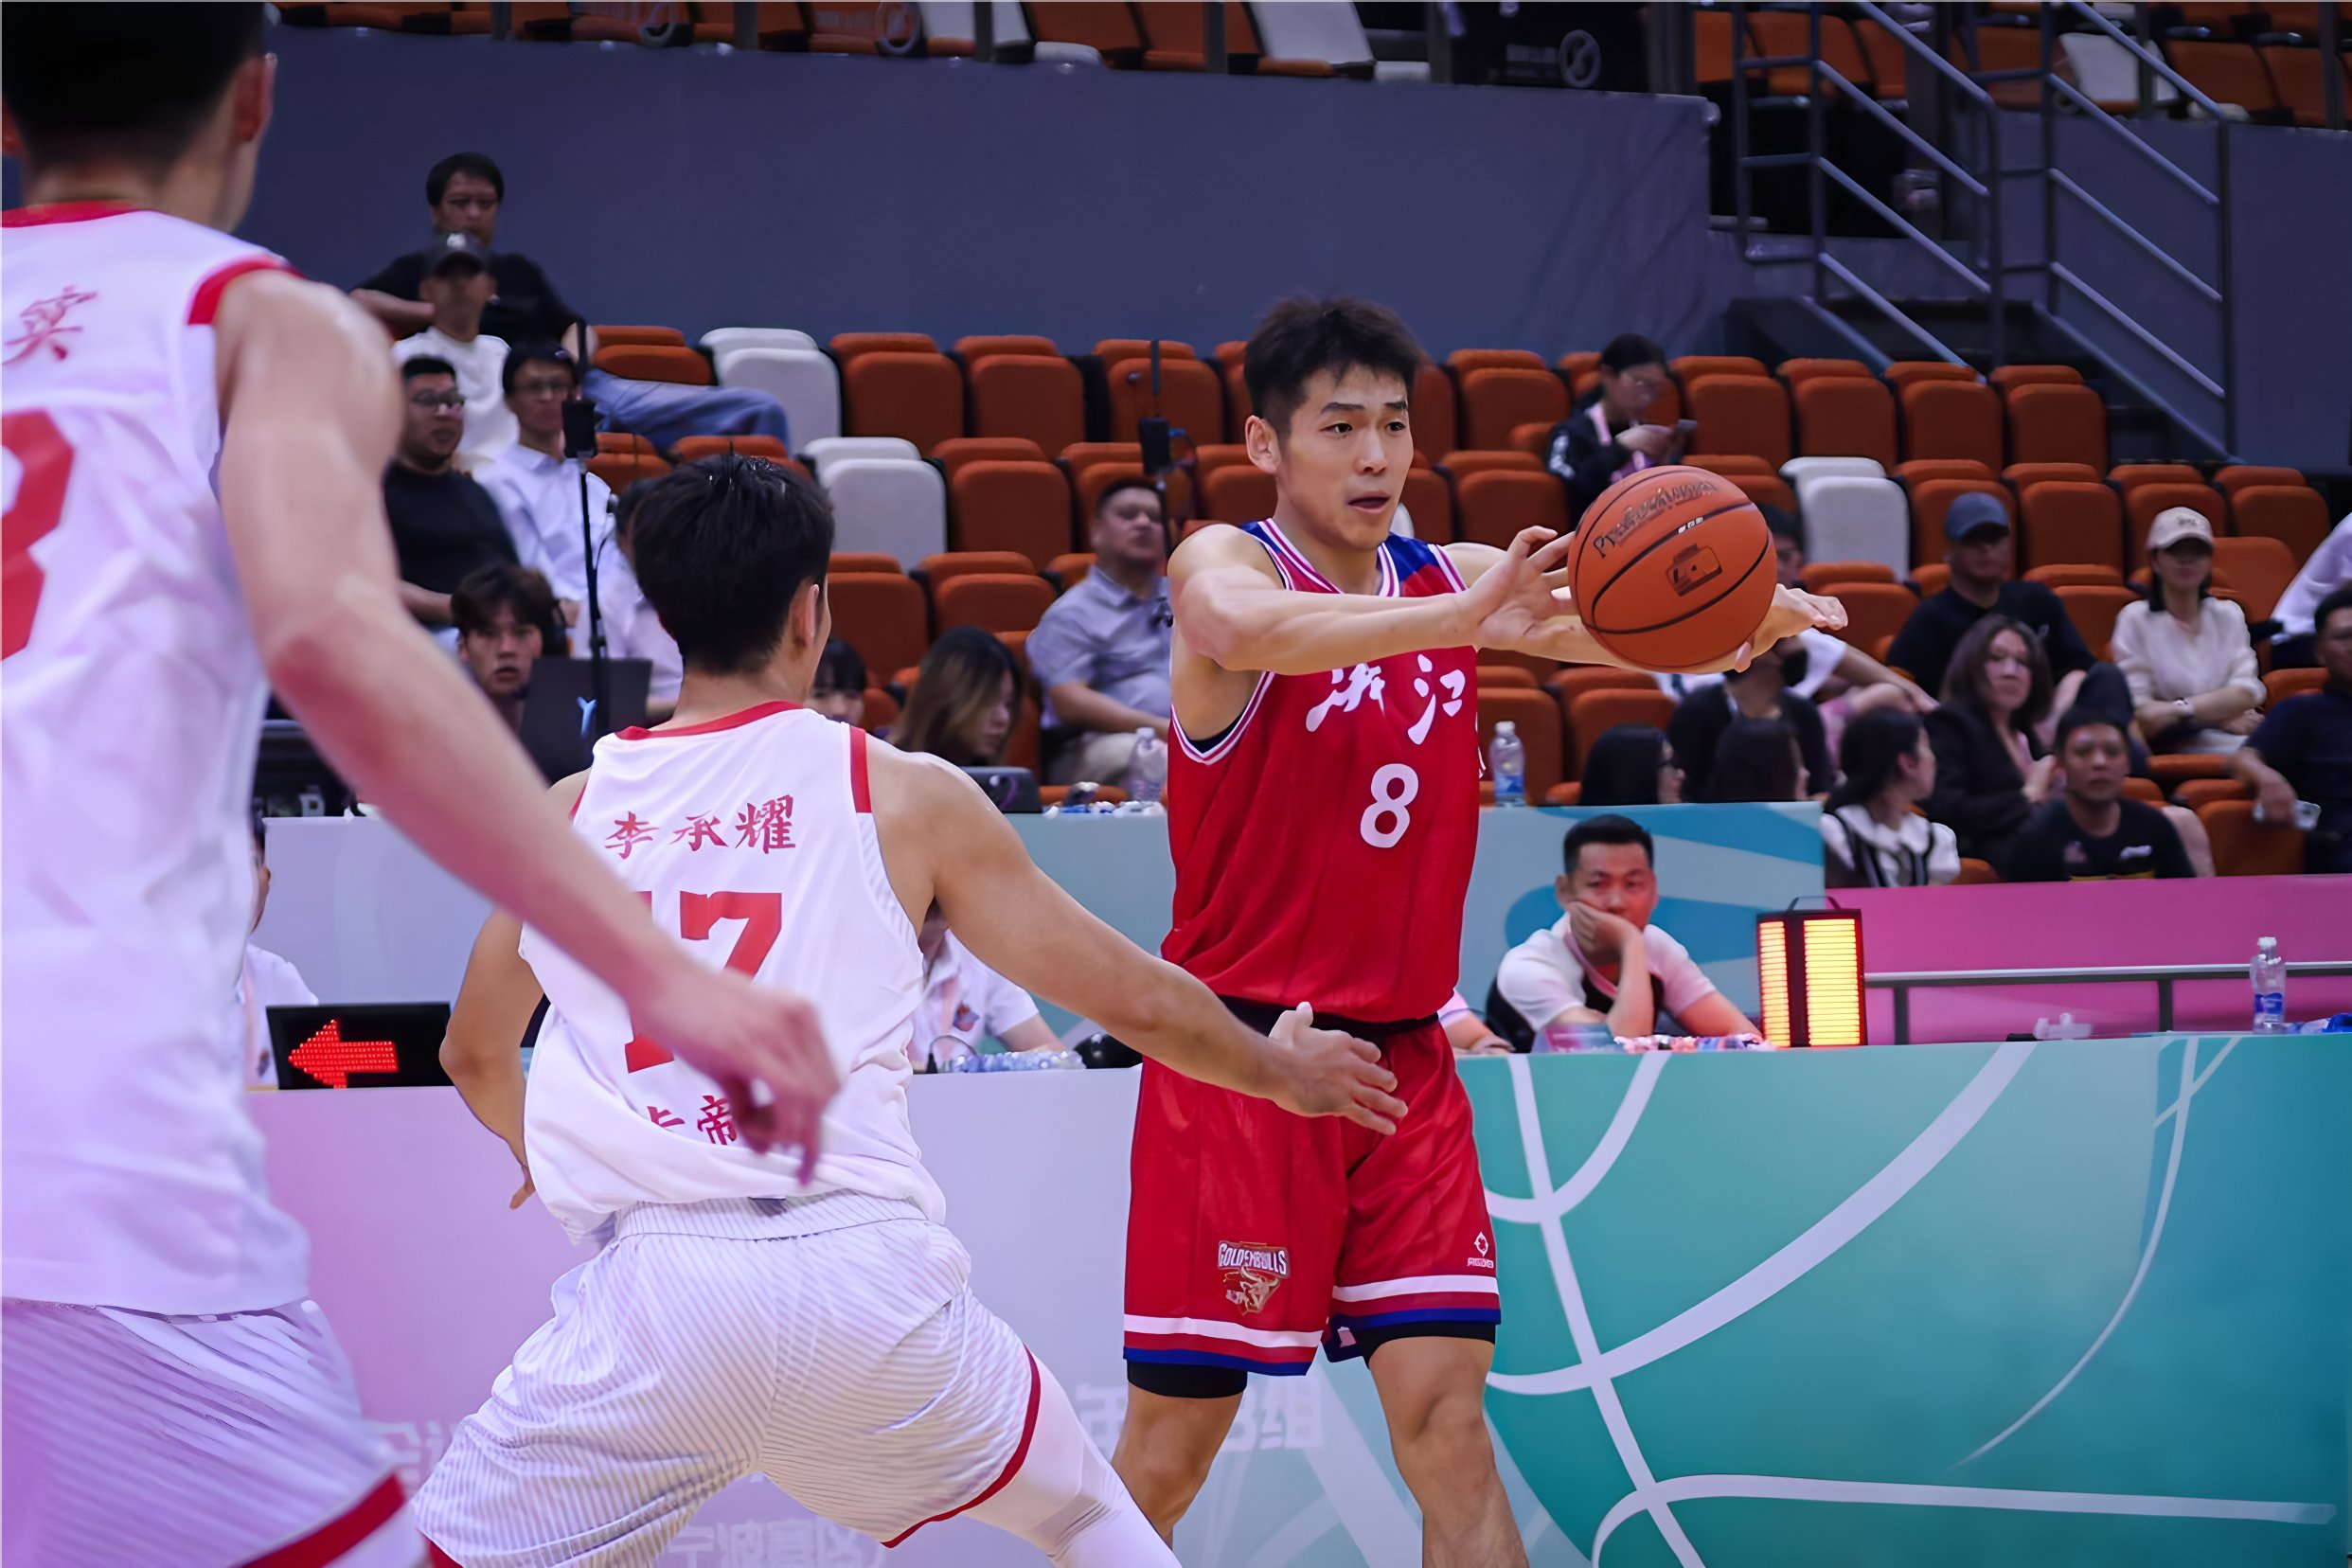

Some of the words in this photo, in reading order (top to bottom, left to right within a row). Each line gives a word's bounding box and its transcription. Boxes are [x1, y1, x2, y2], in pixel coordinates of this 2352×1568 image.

[604, 793, 796, 860] 李承耀
[1360, 763, 1419, 848] 8
[625, 890, 782, 1074] 7
